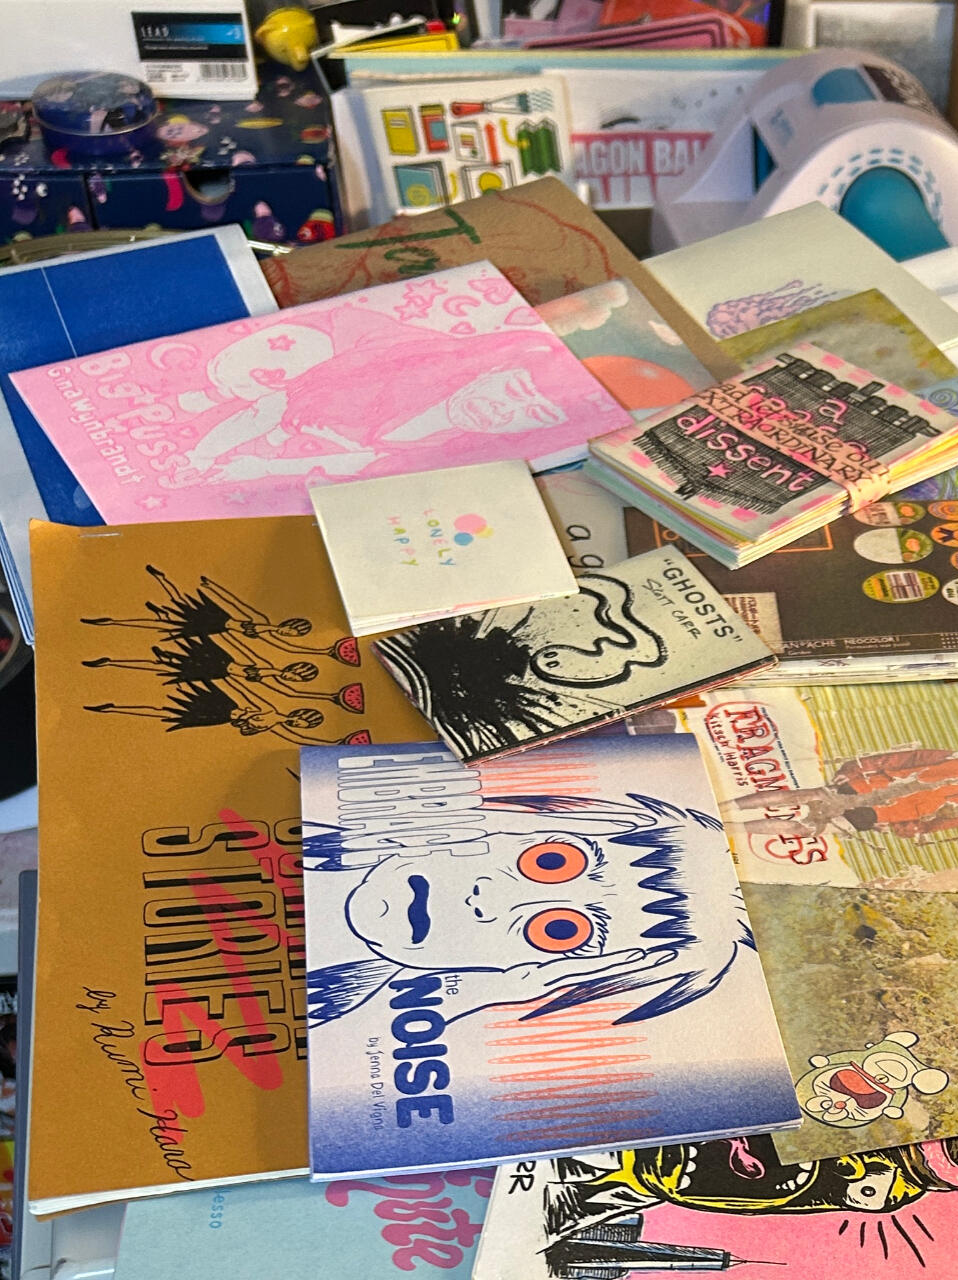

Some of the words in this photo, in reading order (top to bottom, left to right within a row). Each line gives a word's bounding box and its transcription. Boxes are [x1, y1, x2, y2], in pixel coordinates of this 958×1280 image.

[676, 414, 817, 492] dissent
[387, 515, 419, 567] HAPPY
[423, 508, 457, 568] LONELY
[723, 751, 750, 787] Harris
[337, 751, 491, 868] EMBRACE
[142, 820, 291, 1067] STORIES
[82, 984, 106, 1014] by
[445, 974, 461, 996] the
[365, 1036, 379, 1053] by
[388, 976, 455, 1129] NOISE
[371, 1081, 384, 1099] Del
